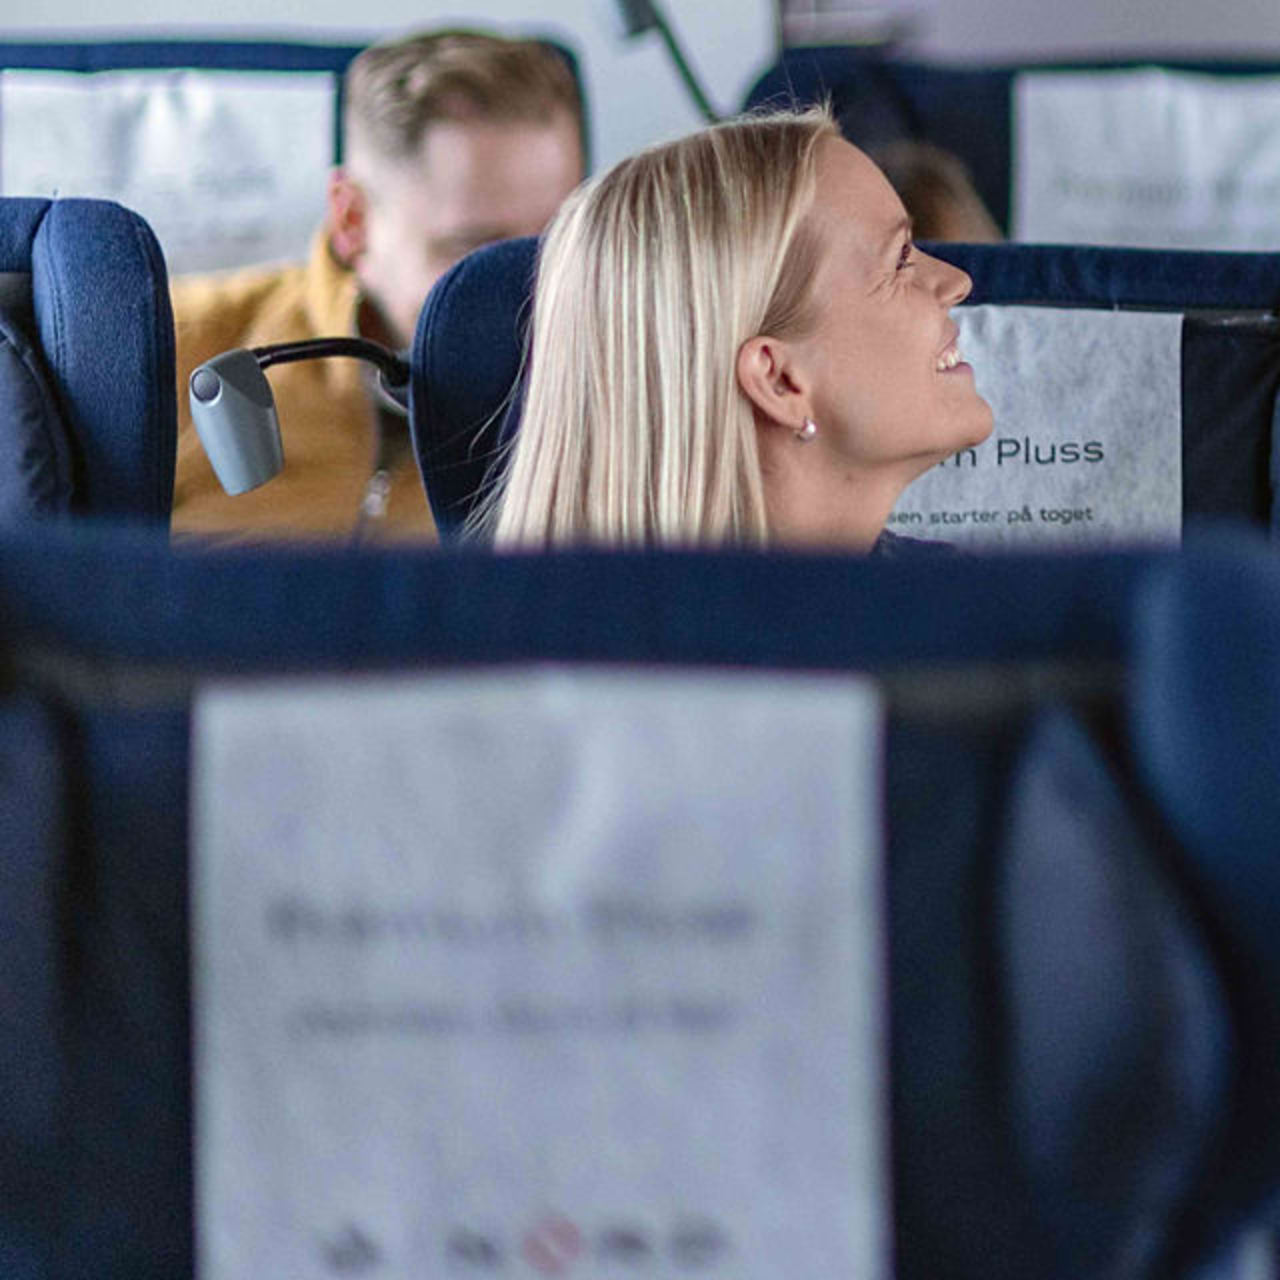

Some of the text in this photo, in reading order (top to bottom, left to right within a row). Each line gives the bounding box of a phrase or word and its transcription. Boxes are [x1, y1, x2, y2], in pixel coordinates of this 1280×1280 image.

[997, 435, 1105, 467] Pluss
[929, 508, 999, 525] starter
[1007, 504, 1033, 524] på
[1040, 506, 1094, 525] toget
